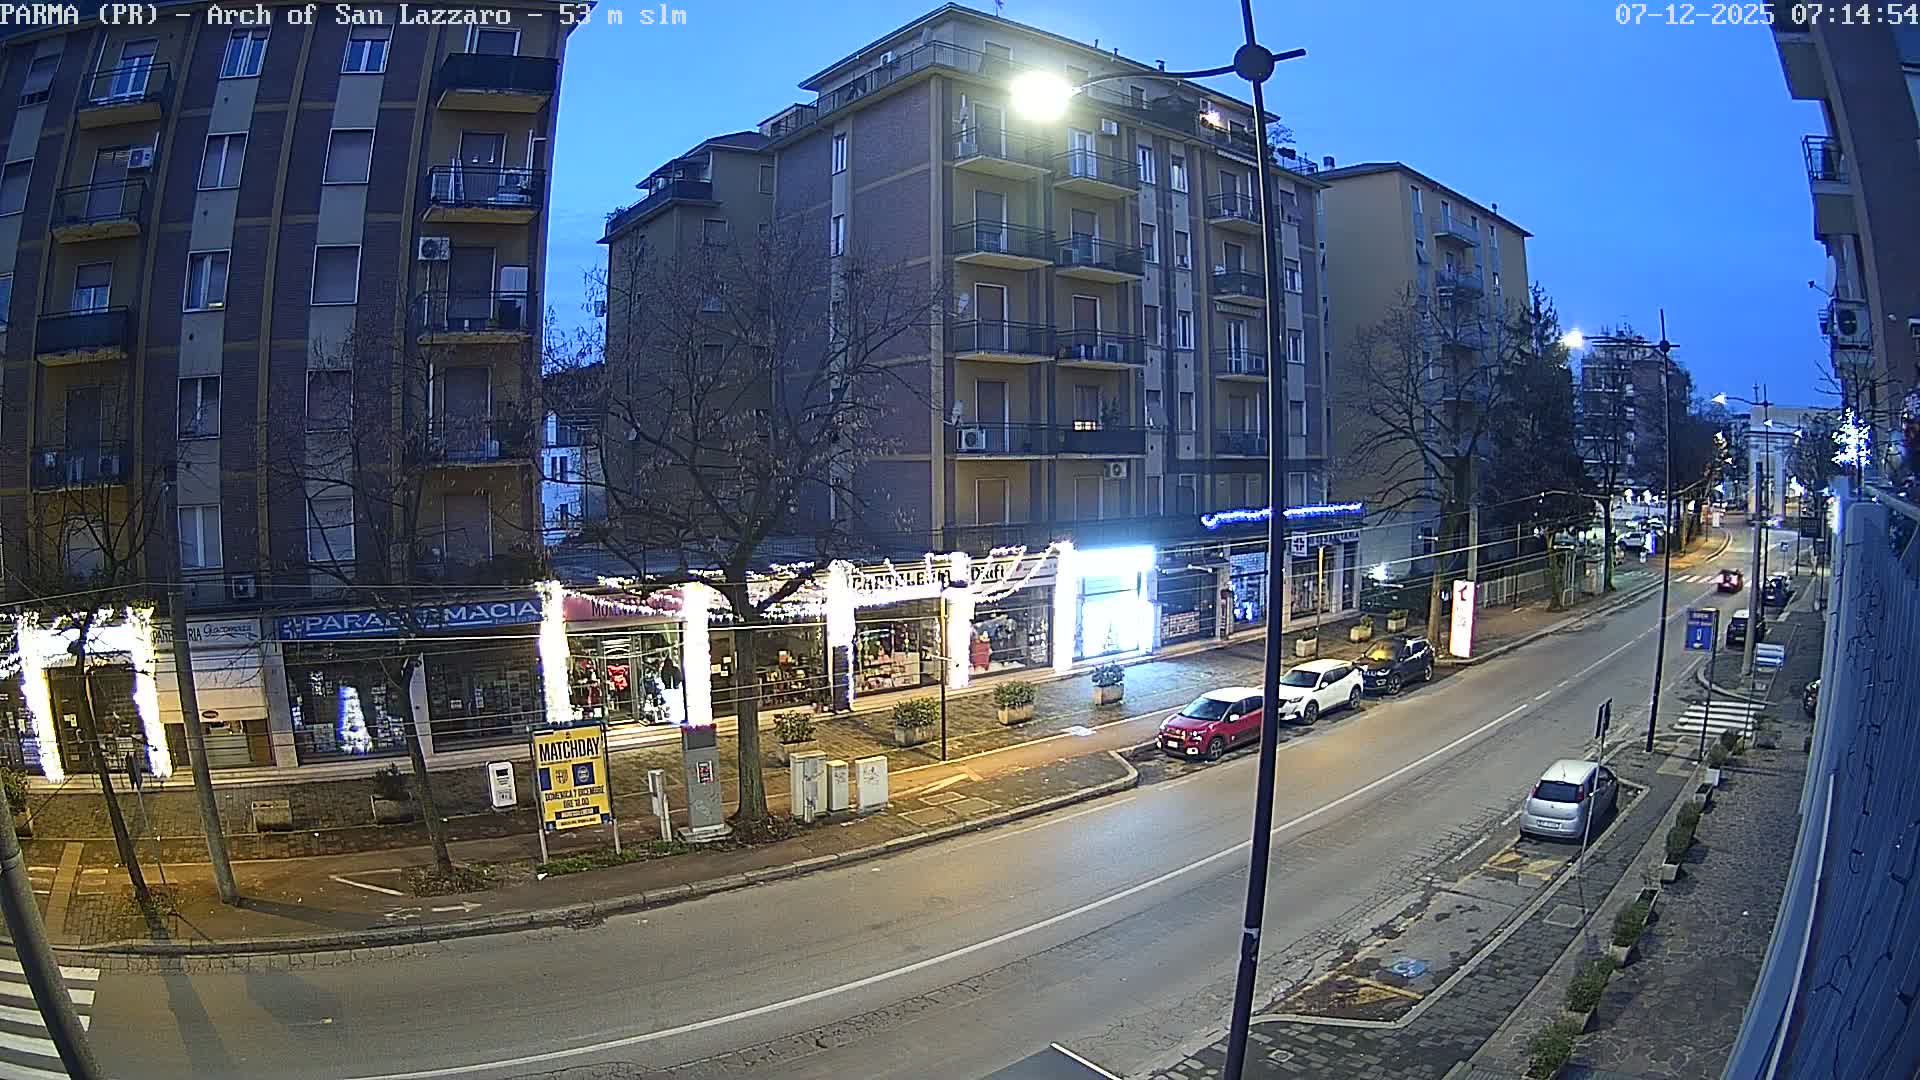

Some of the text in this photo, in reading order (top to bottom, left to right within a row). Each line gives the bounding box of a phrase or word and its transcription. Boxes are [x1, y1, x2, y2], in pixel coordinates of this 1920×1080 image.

[852, 569, 951, 591] CARTOLEIA
[305, 601, 539, 632] PARAFMACIA
[539, 737, 600, 761] MATCHDAY
